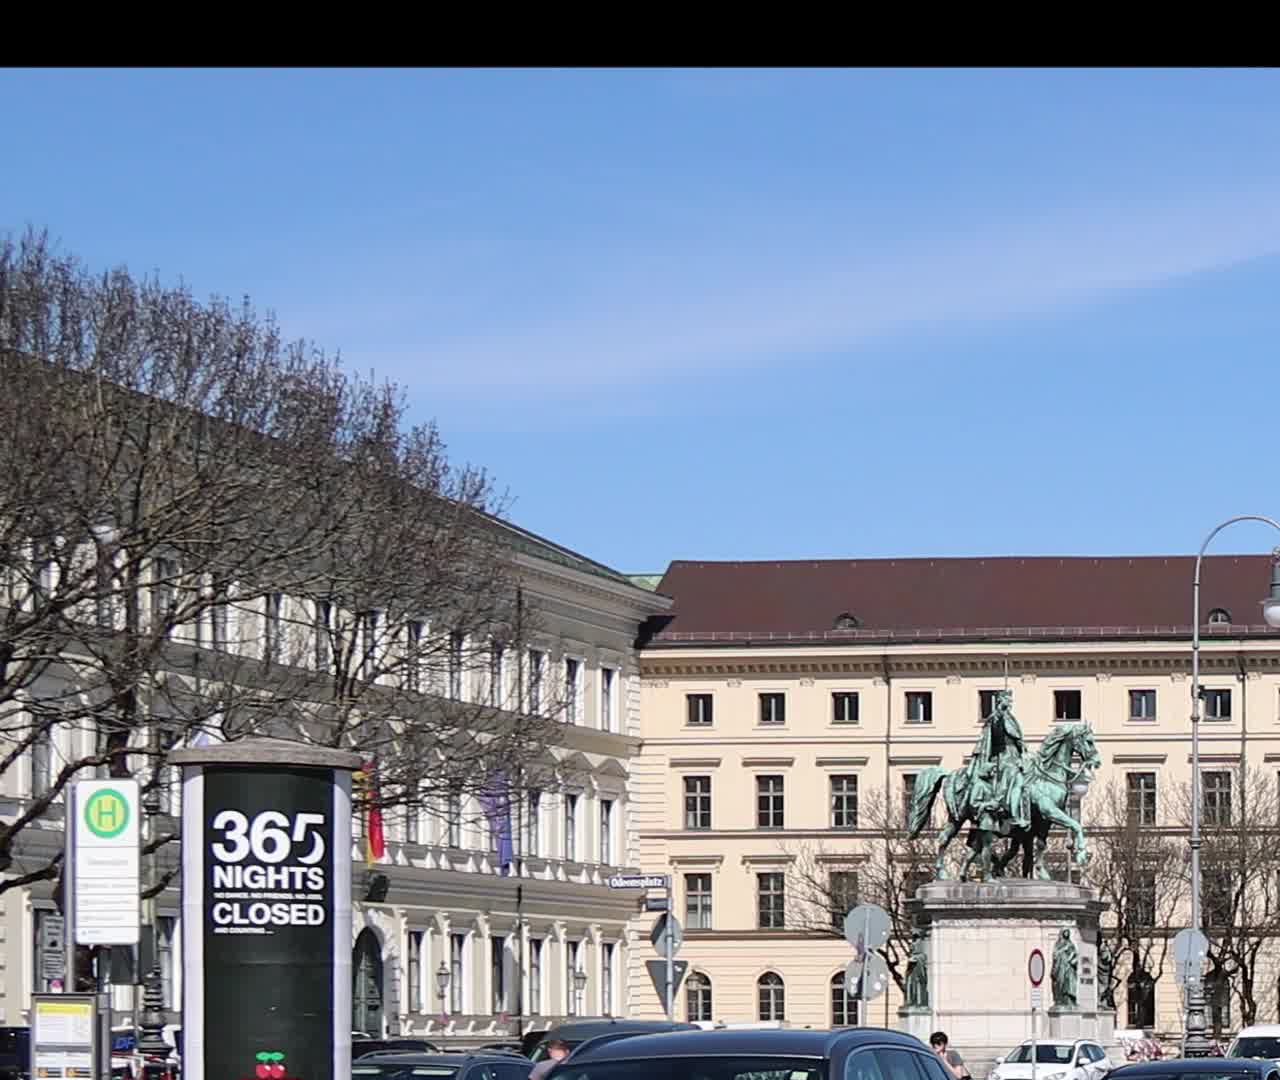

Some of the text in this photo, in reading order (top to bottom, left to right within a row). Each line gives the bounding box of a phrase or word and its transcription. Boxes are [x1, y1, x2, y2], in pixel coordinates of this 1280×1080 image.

[212, 810, 325, 864] 365
[213, 865, 325, 890] NIGHTS
[213, 902, 325, 925] CLOSED
